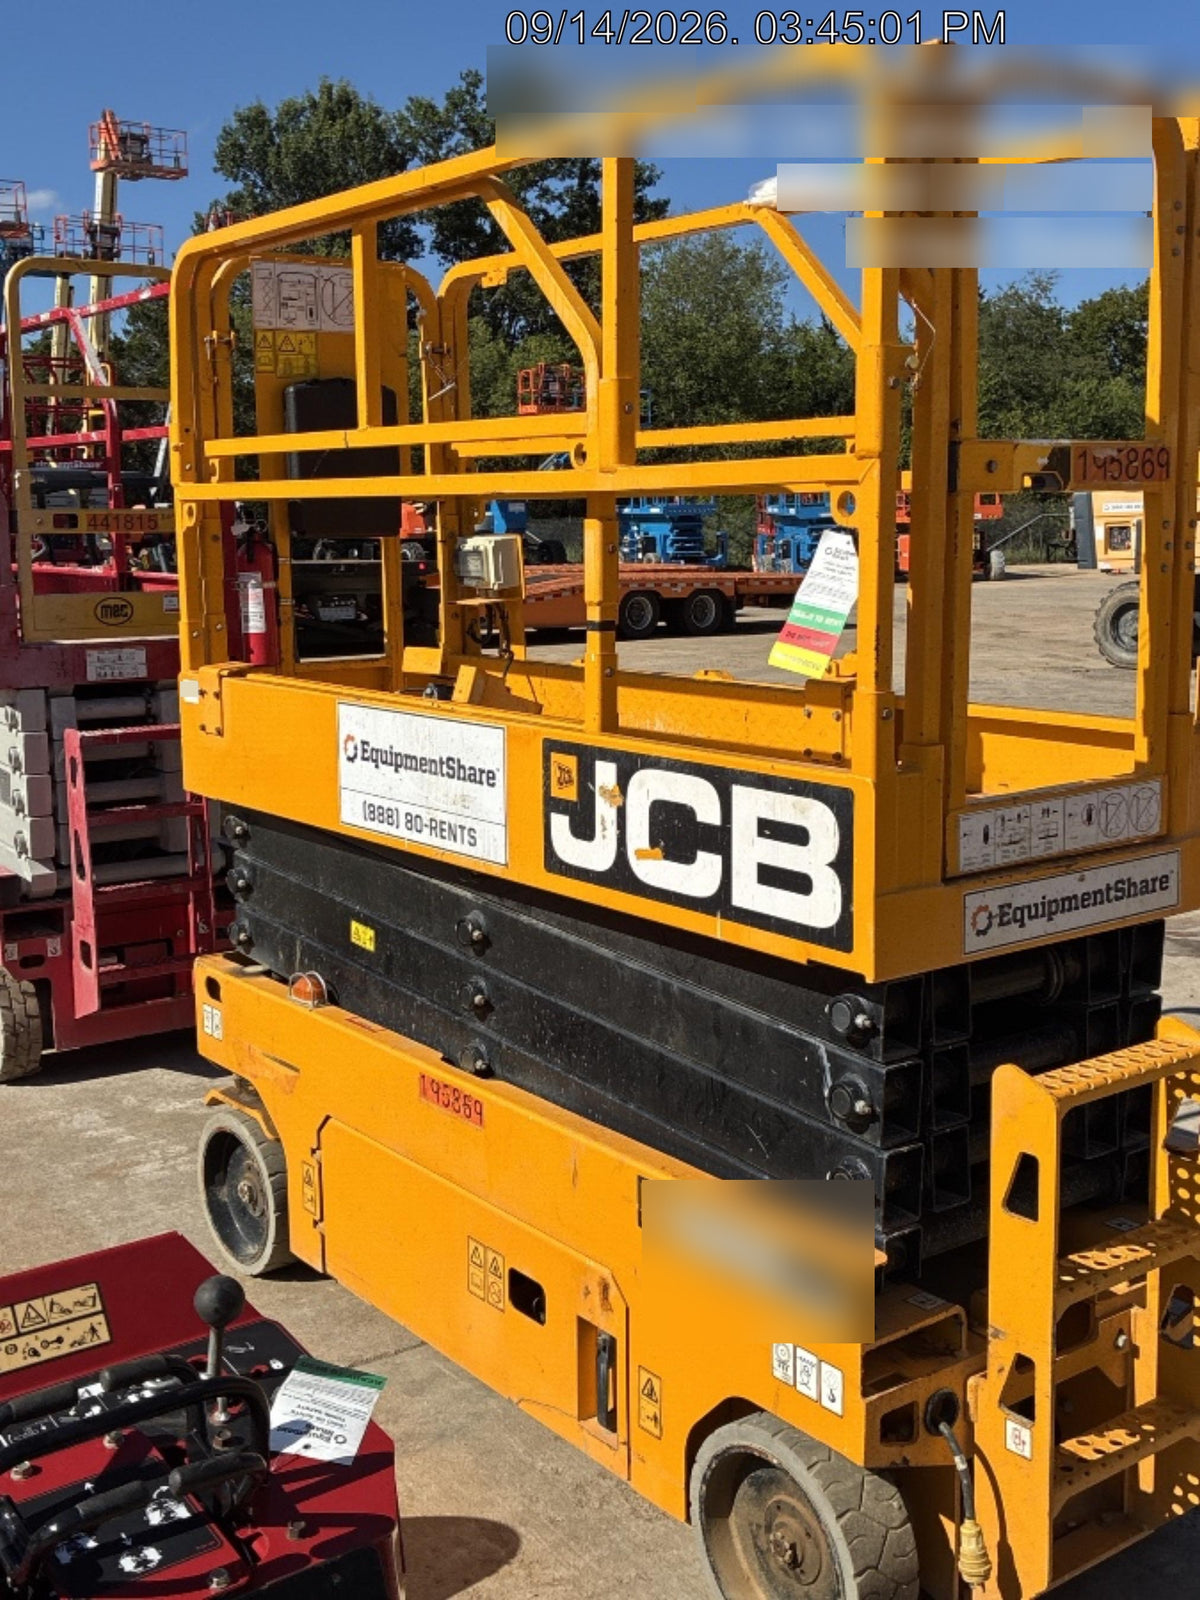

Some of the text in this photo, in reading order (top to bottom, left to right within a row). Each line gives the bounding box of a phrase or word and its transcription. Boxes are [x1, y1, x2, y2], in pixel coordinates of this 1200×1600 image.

[87, 512, 159, 530] 441815
[360, 740, 497, 788] EquipmentShare
[362, 799, 478, 848] (888) 80-RENTS
[550, 760, 842, 928] JCB
[997, 873, 1169, 929] EquipmentShare
[420, 1073, 483, 1126] 195869
